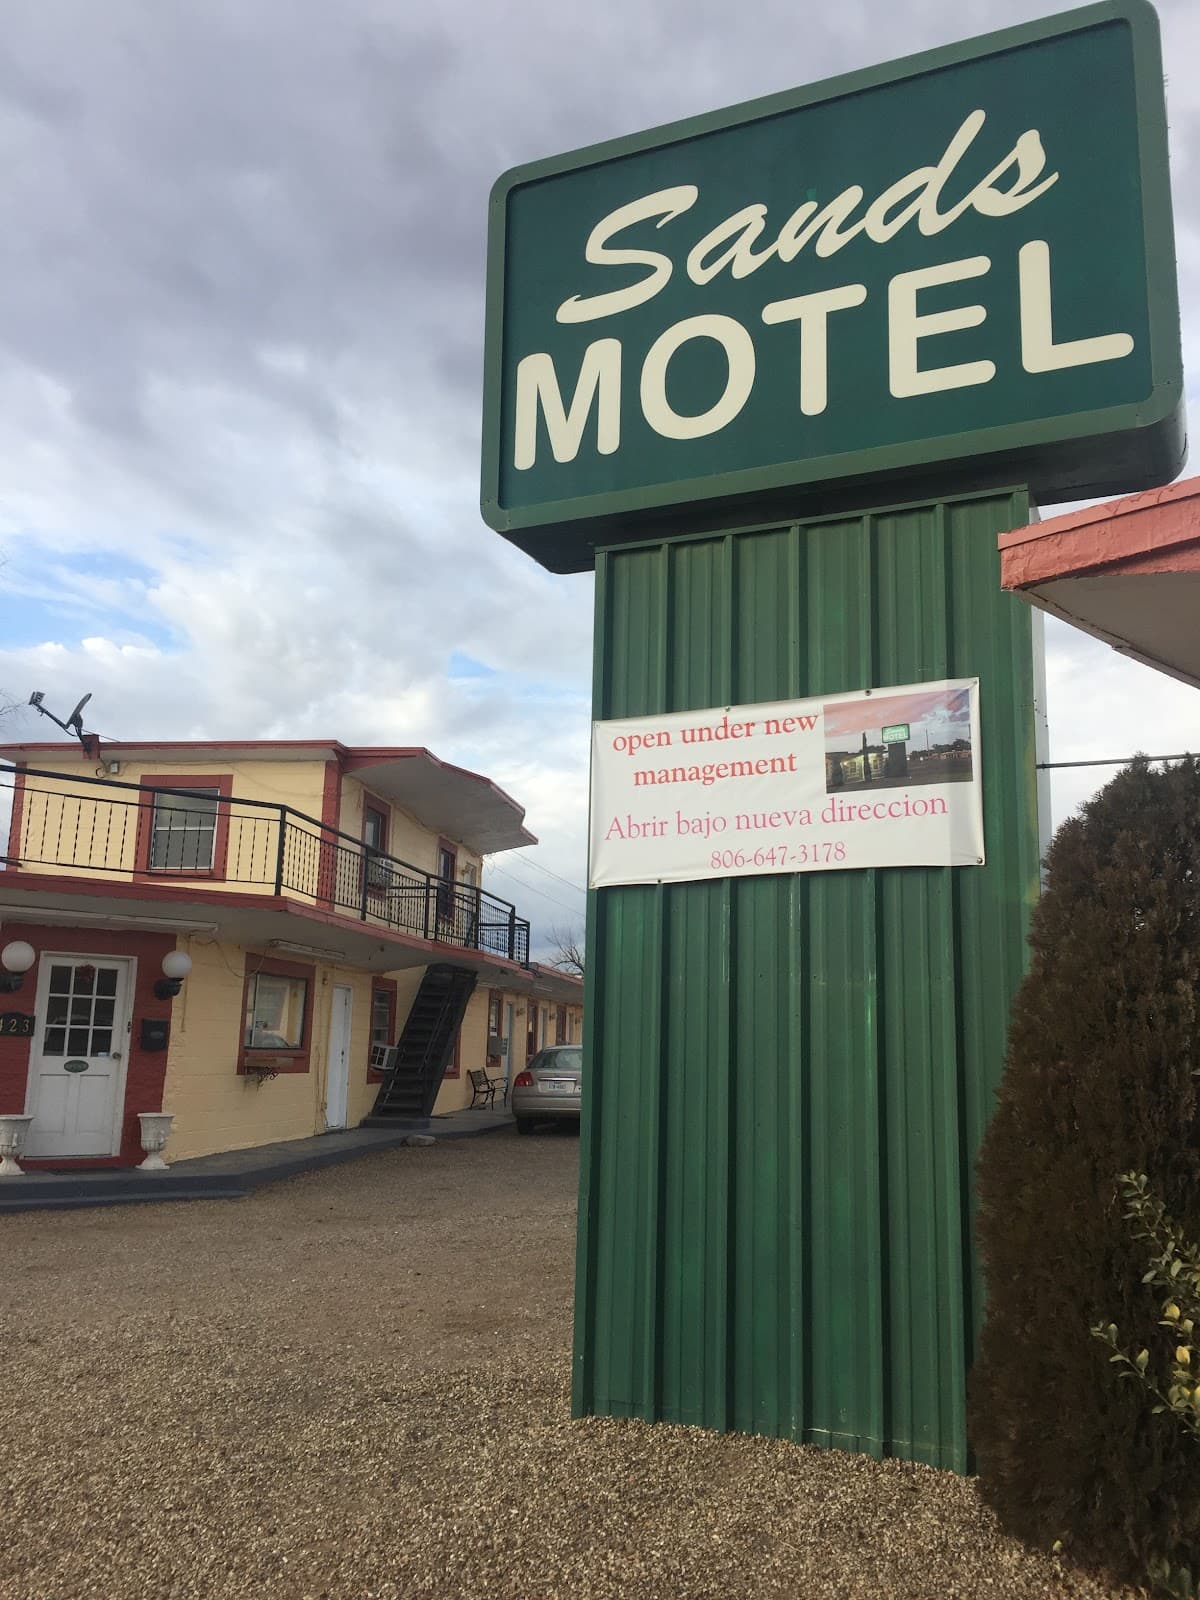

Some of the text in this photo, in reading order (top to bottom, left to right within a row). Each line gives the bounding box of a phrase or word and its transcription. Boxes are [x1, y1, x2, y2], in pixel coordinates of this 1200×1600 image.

[556, 109, 1059, 324] Sands
[514, 240, 1134, 471] MOTEL
[612, 714, 819, 756] open under new
[633, 752, 797, 786] management
[604, 794, 949, 841] Abrir bajo nueva direccion
[711, 841, 847, 870] 806-647-3178
